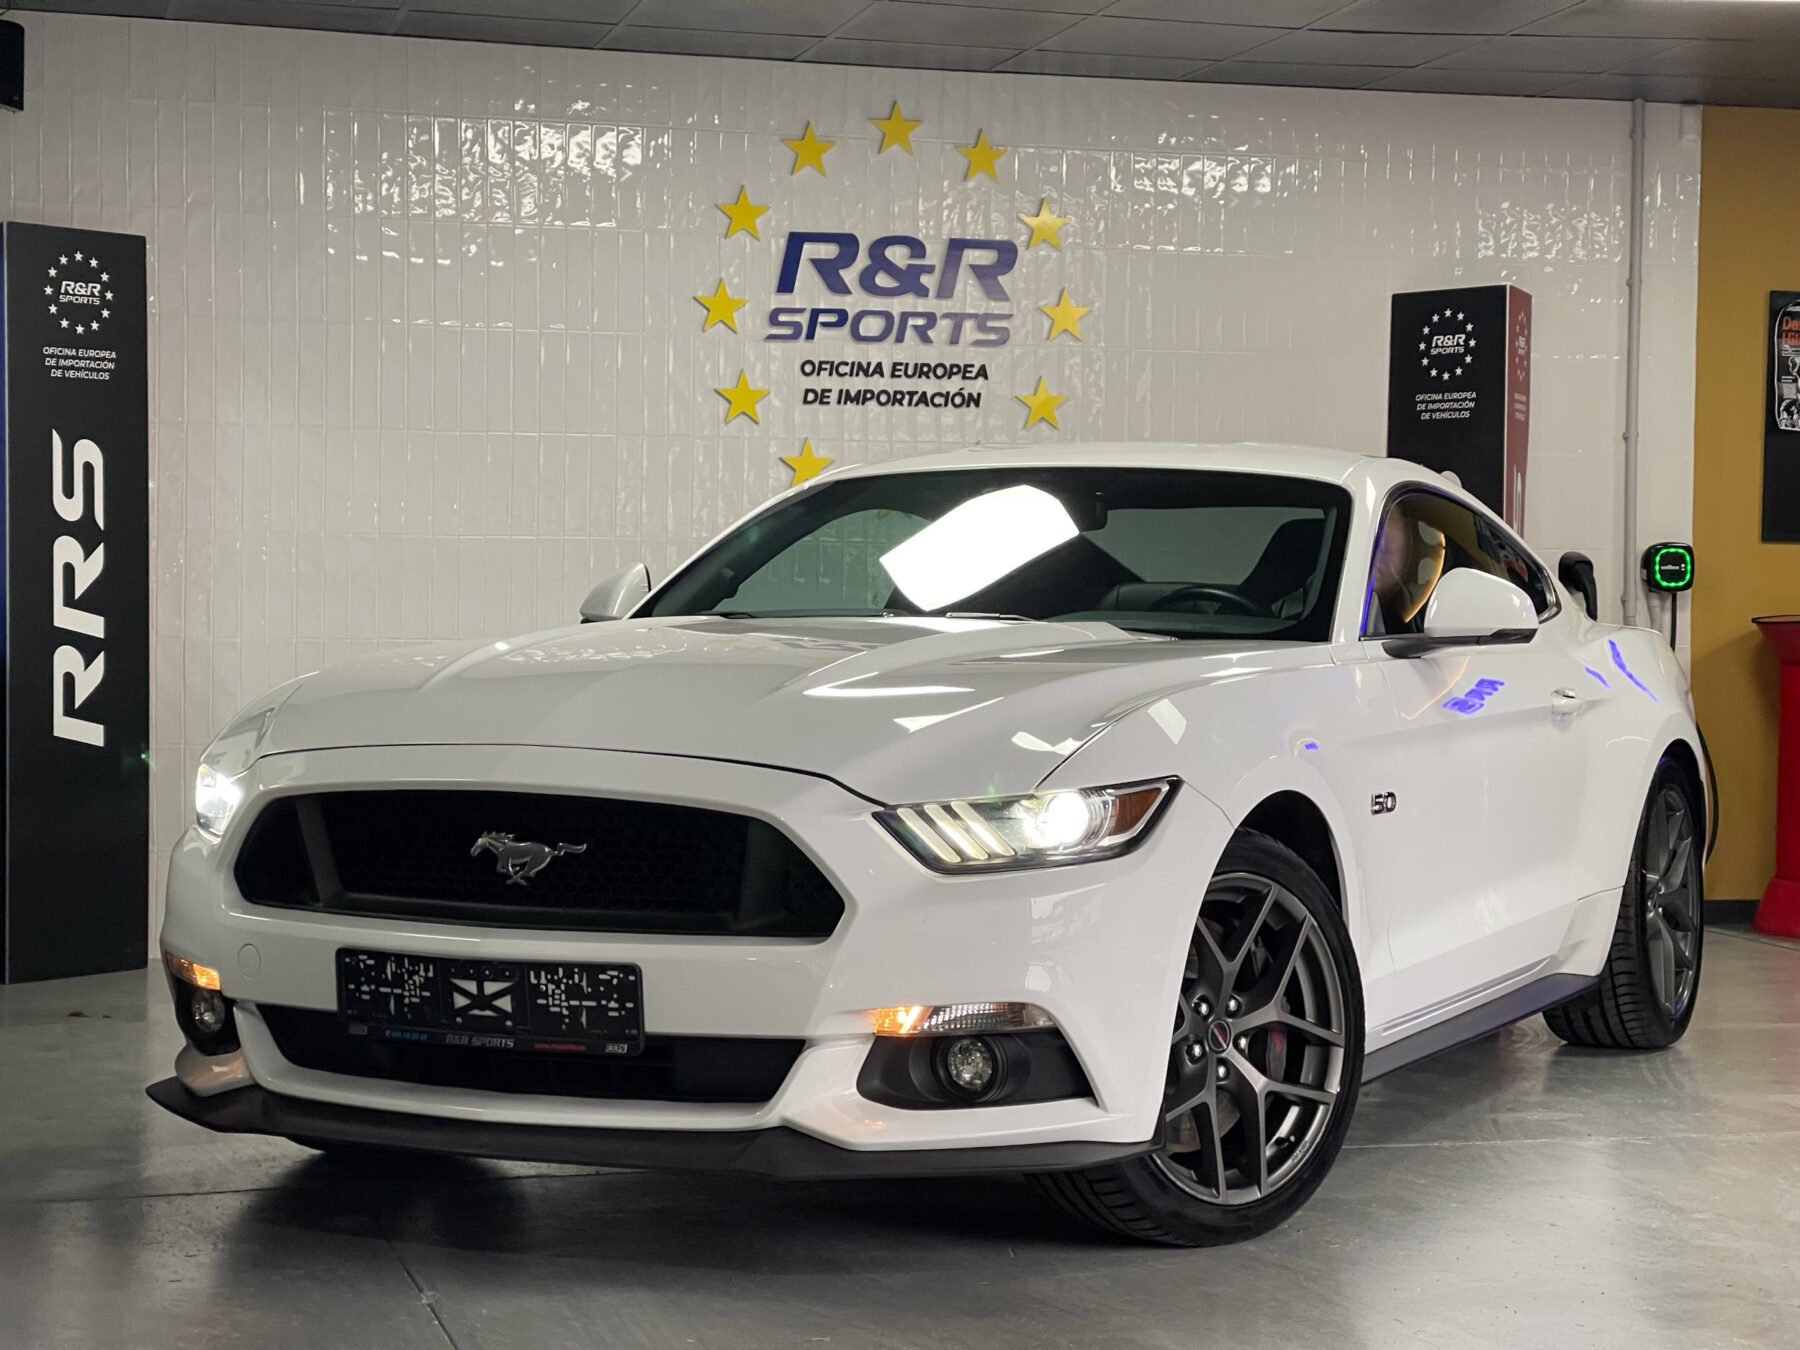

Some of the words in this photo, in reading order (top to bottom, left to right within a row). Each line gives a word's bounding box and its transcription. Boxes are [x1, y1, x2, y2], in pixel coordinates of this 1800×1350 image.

[777, 231, 1018, 301] R&R
[61, 281, 101, 296] R&R
[59, 295, 100, 305] SPORTS
[764, 307, 1014, 346] SPORTS
[1432, 334, 1466, 347] R&R
[42, 346, 77, 357] OFICINA
[78, 348, 117, 359] EUROPEA
[1430, 346, 1465, 355] SPORTS
[45, 357, 57, 366] DE
[58, 358, 115, 370] IMPORTACIÓN
[50, 369, 63, 378] DE
[64, 369, 110, 380] VEHÍCULOS
[800, 360, 885, 379] OFICINA
[890, 362, 989, 381] EUROPEA
[802, 388, 832, 406] DE
[837, 387, 982, 408] IMPORTACIÓN
[1415, 393, 1443, 401] OFICINA
[1444, 391, 1477, 400] EUROPEA
[1416, 402, 1427, 411] DE
[1427, 400, 1475, 411] IMPORTACIÓN
[1420, 412, 1431, 420] DE
[1432, 411, 1470, 419] VEHÍCULOS
[52, 428, 105, 748] RRS
[471, 1035, 515, 1049] SPORTS
